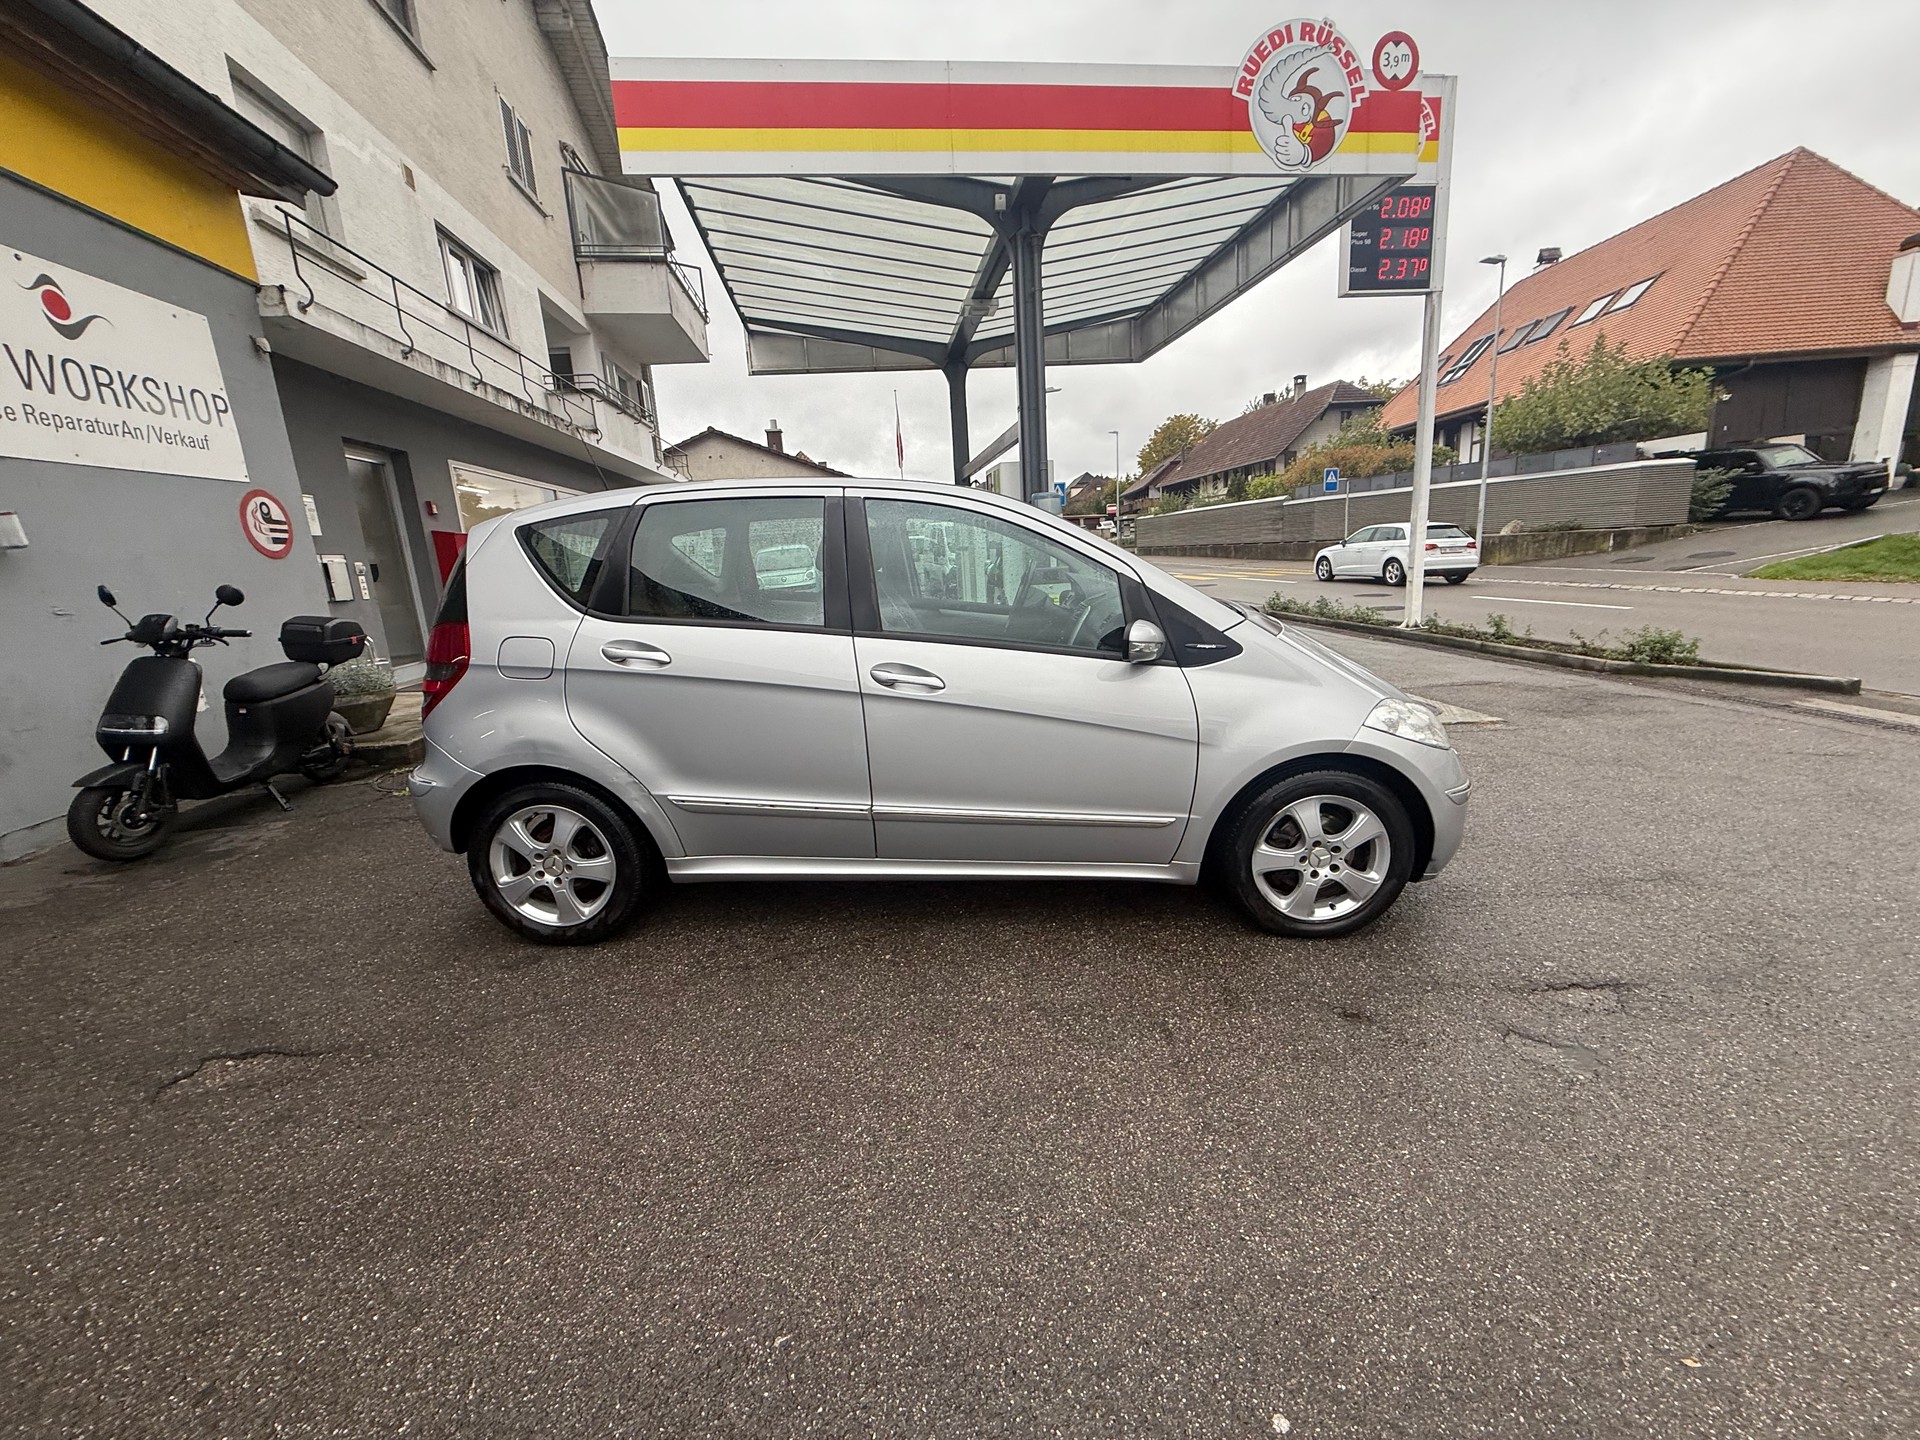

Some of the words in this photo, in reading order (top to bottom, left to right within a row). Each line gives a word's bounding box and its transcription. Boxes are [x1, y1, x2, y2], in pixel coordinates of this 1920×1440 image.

[1236, 24, 1294, 96] RUEDI
[1300, 20, 1365, 103] RÜSSEL
[1381, 196, 1431, 219] 2.080
[1351, 230, 1369, 239] Super
[1379, 227, 1429, 249] 2.180
[1378, 257, 1428, 280] 2.370
[2, 343, 230, 427] WORKSHOP
